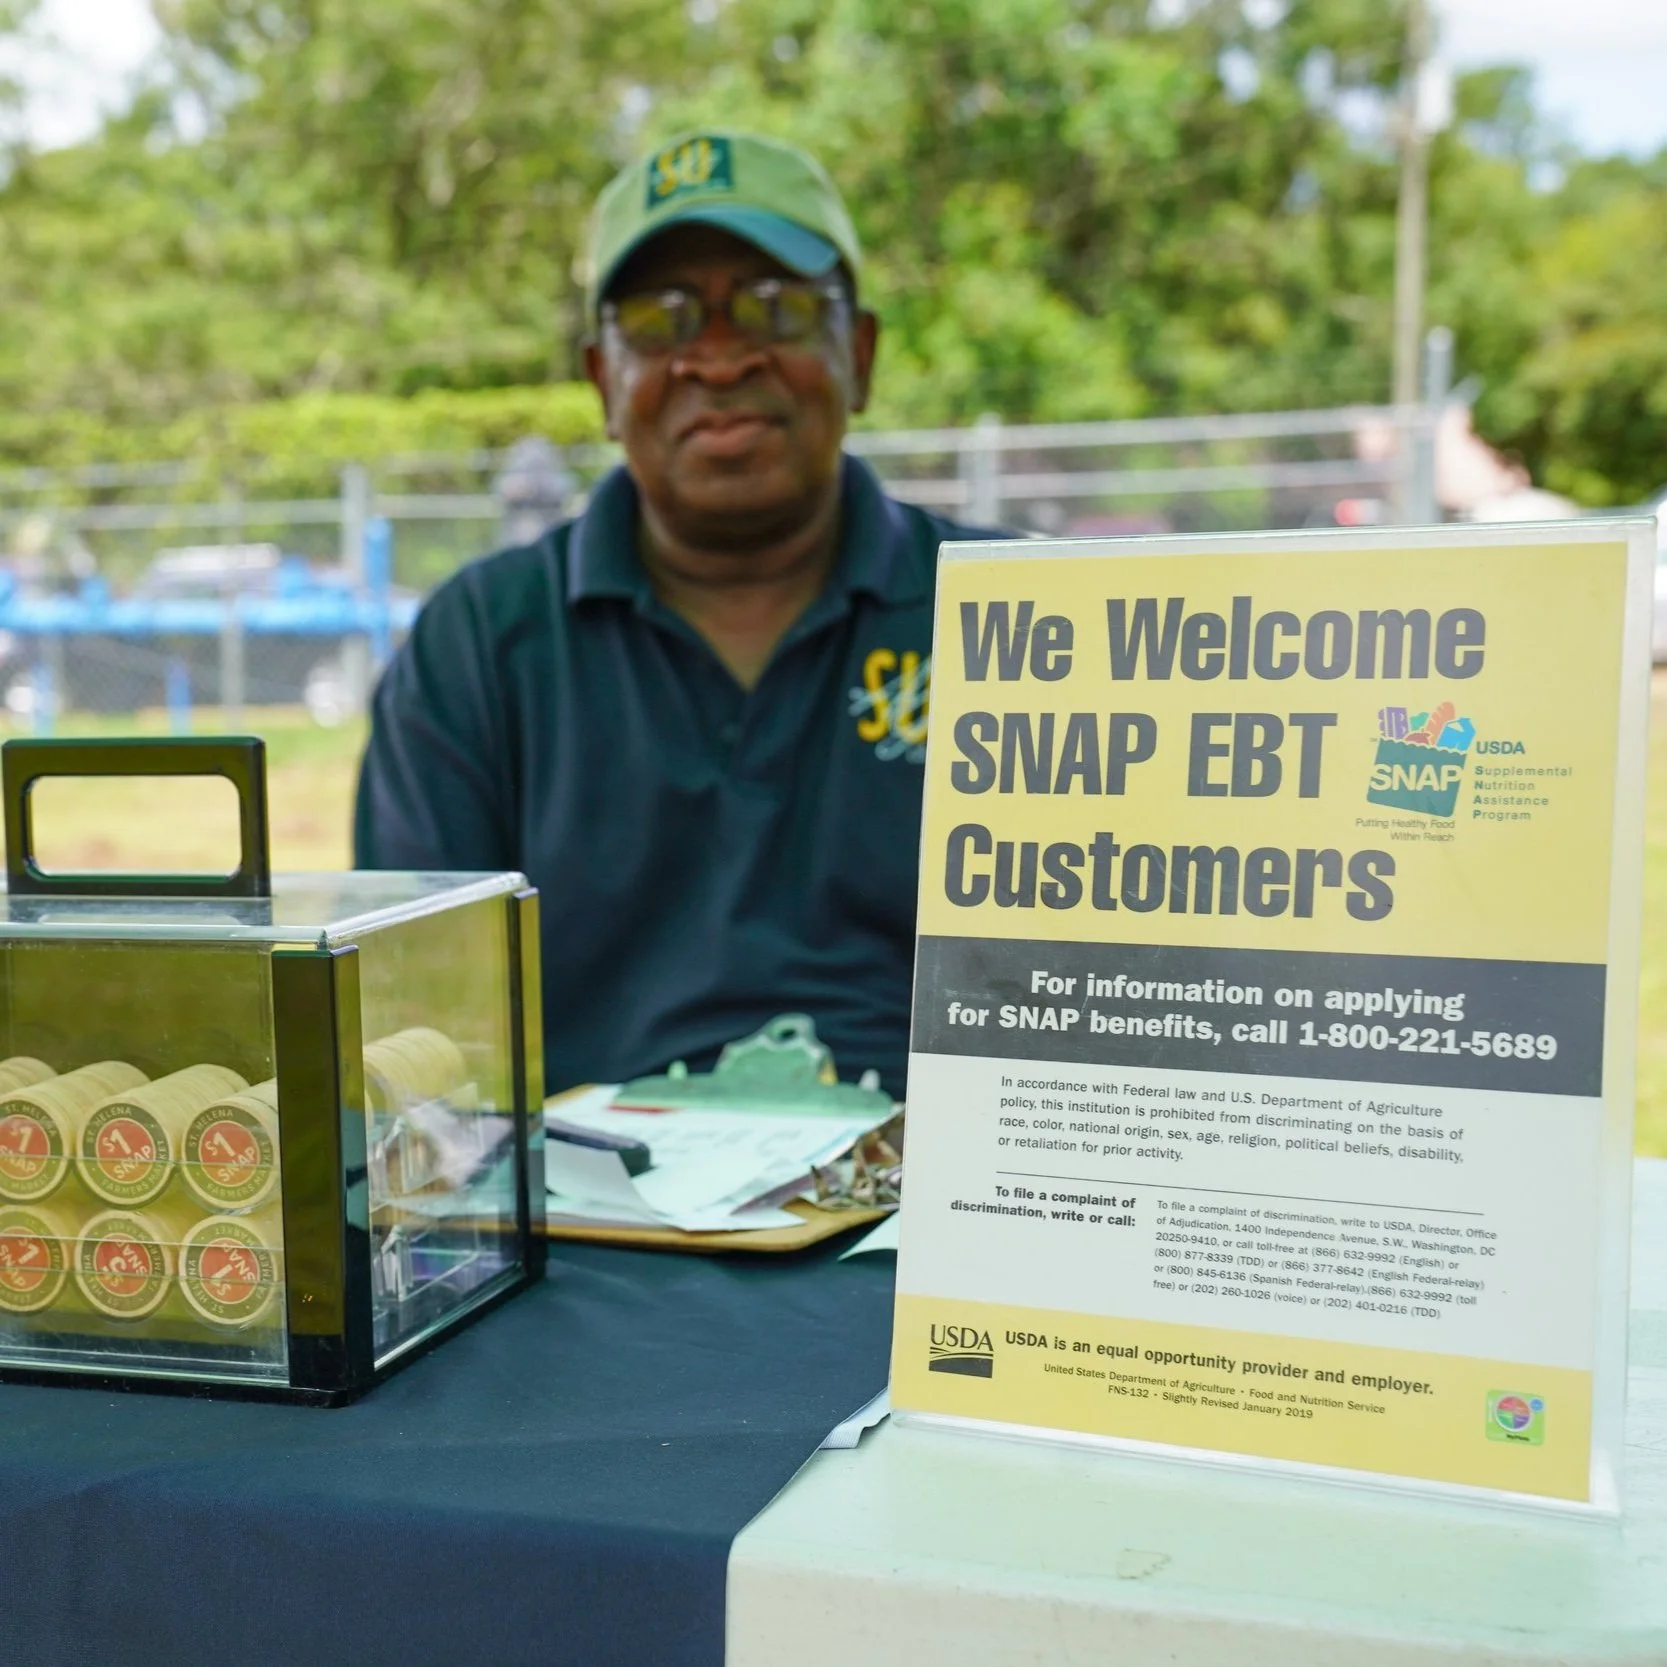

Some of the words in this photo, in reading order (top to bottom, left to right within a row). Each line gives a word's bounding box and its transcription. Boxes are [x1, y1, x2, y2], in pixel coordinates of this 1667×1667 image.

[960, 601, 1074, 682] We
[1107, 596, 1485, 682] Welcome
[950, 711, 1158, 796] SNAP
[1186, 712, 1339, 800] EBT
[1476, 741, 1526, 755] USDA
[1370, 763, 1463, 792] SNAP
[1475, 765, 1573, 777] Supplemental
[1475, 781, 1535, 791] Nutrition
[1473, 795, 1549, 806] Assistance
[1473, 809, 1531, 821] Program
[1356, 818, 1389, 830] Putting
[1392, 818, 1427, 829] Healthy
[1430, 818, 1456, 829] Food
[1390, 832, 1421, 841] Within
[1423, 832, 1454, 842] Reach
[945, 823, 1396, 922] Customers
[1031, 970, 1077, 995] For
[1086, 972, 1263, 1005] information
[1274, 988, 1313, 1008] on
[1324, 987, 1465, 1020] applying
[947, 1001, 989, 1026] for
[998, 1004, 1080, 1031] SNAP
[1090, 1009, 1222, 1045] benefits,
[1231, 1019, 1288, 1044] call
[1299, 1021, 1557, 1060] 1-800-221-5689
[1001, 1075, 1012, 1087] In
[1016, 1079, 1088, 1093] accordance
[1091, 1082, 1118, 1095] with
[1122, 1083, 1170, 1098] Federal
[1174, 1087, 1197, 1100] law
[1200, 1090, 1226, 1102] and
[1230, 1091, 1256, 1104] U.S.
[1260, 1093, 1343, 1111] Department
[1347, 1099, 1362, 1112] of
[1366, 1100, 1443, 1117] Agriculture
[195, 1109, 233, 1129] HELENA
[999, 1096, 1037, 1111] policy,
[1040, 1098, 1064, 1111] this
[1068, 1099, 1130, 1116] institution
[1135, 1104, 1146, 1117] is
[1149, 1107, 1215, 1122] prohibited
[1219, 1110, 1251, 1124] from
[1255, 1113, 1353, 1135] discriminating
[1357, 1123, 1374, 1133] on
[1379, 1123, 1402, 1136] the
[1407, 1124, 1444, 1139] basis
[1449, 1128, 1464, 1140] of
[997, 1136, 1011, 1146] or
[1014, 1137, 1077, 1151] retaliation
[1081, 1140, 1099, 1153] for
[1102, 1143, 1132, 1156] prior
[1135, 1146, 1183, 1162] activity.
[999, 1117, 1029, 1129] race,
[1032, 1117, 1065, 1132] color,
[1069, 1121, 1120, 1135] national
[1123, 1125, 1163, 1140] origin,
[1167, 1129, 1192, 1142] sex,
[1196, 1131, 1224, 1145] age,
[1228, 1132, 1281, 1148] religion,
[1285, 1137, 1339, 1152] political
[1343, 1140, 1393, 1157] beliefs,
[113, 1145, 152, 1179] SNAP
[217, 1146, 256, 1182] SNAP
[950, 1199, 1046, 1220] discrimination,
[1050, 1209, 1084, 1222] write
[1088, 1214, 1103, 1224] or
[1107, 1215, 1136, 1227] call:
[995, 1185, 1010, 1197] To
[1013, 1187, 1034, 1200] file
[1038, 1191, 1047, 1201] a
[1051, 1193, 1117, 1207] complaint
[1121, 1197, 1136, 1208] of
[1156, 1199, 1168, 1210] To
[1170, 1200, 1186, 1211] file
[1188, 1204, 1195, 1212] a
[1198, 1205, 1247, 1217] complaint
[1250, 1208, 1261, 1218] of
[1262, 1210, 1338, 1226] discrimination,
[1340, 1217, 1366, 1228] write
[1369, 1219, 1380, 1229] to
[1465, 1227, 1498, 1240] Office
[1156, 1216, 1167, 1225] of
[1234, 1223, 1262, 1234] 1400
[1264, 1226, 1336, 1241] Independence
[1479, 1245, 1496, 1257] DC
[1154, 1247, 1182, 1260] (800)
[1183, 1250, 1234, 1264] 877-8339
[1236, 1255, 1265, 1268] (TDD)
[1267, 1260, 1278, 1268] or
[1280, 1260, 1310, 1272] (866)
[1312, 1263, 1365, 1277] 377-8642
[1367, 1268, 1409, 1282] (English
[1412, 1272, 1485, 1291] Federal-relay)
[1222, 1239, 1233, 1247] or
[1235, 1240, 1254, 1249] call
[1256, 1241, 1295, 1254] toll-free
[1297, 1246, 1308, 1255] at
[1311, 1246, 1340, 1259] (866)
[1342, 1249, 1396, 1264] 632-9992
[1398, 1255, 1445, 1269] (English)
[1447, 1261, 1460, 1270] or
[1152, 1279, 1176, 1292] free)
[1177, 1283, 1189, 1291] or
[1190, 1283, 1218, 1296] (202)
[1220, 1286, 1271, 1300] 260-1026
[1273, 1291, 1307, 1305] (voice)
[1309, 1297, 1321, 1305] or
[1323, 1297, 1352, 1310] (202)
[1354, 1300, 1408, 1315] 401-0216
[1410, 1306, 1441, 1320] (TDD)
[1153, 1265, 1164, 1273] or
[1166, 1264, 1194, 1277] (800)
[1196, 1267, 1246, 1281] 845-6136
[1248, 1272, 1292, 1286] (Spanish
[1399, 1288, 1453, 1303] 632-9992
[1455, 1294, 1477, 1305] (toll
[930, 1323, 994, 1351] USDA
[1005, 1330, 1048, 1348] USDA
[1054, 1335, 1066, 1351] is
[1072, 1341, 1090, 1353] an
[1096, 1344, 1138, 1359] equal
[1144, 1350, 1236, 1373] opportunity
[1242, 1361, 1308, 1379] provider
[1314, 1369, 1344, 1384] and
[1351, 1374, 1433, 1395] employer.
[1044, 1363, 1074, 1375] United
[1075, 1366, 1106, 1379] States
[1108, 1370, 1167, 1387] Department
[1169, 1379, 1180, 1388] of
[1182, 1380, 1236, 1395] Agriculture
[1249, 1388, 1274, 1400] Food
[1276, 1393, 1297, 1403] and
[1299, 1394, 1344, 1408] Nutrition
[1347, 1400, 1385, 1414] Service
[1108, 1384, 1149, 1398] FNS-132
[1162, 1391, 1198, 1406] Slightly
[1200, 1396, 1239, 1410] Revised
[1242, 1401, 1282, 1417] January
[1284, 1406, 1313, 1419] 2019
